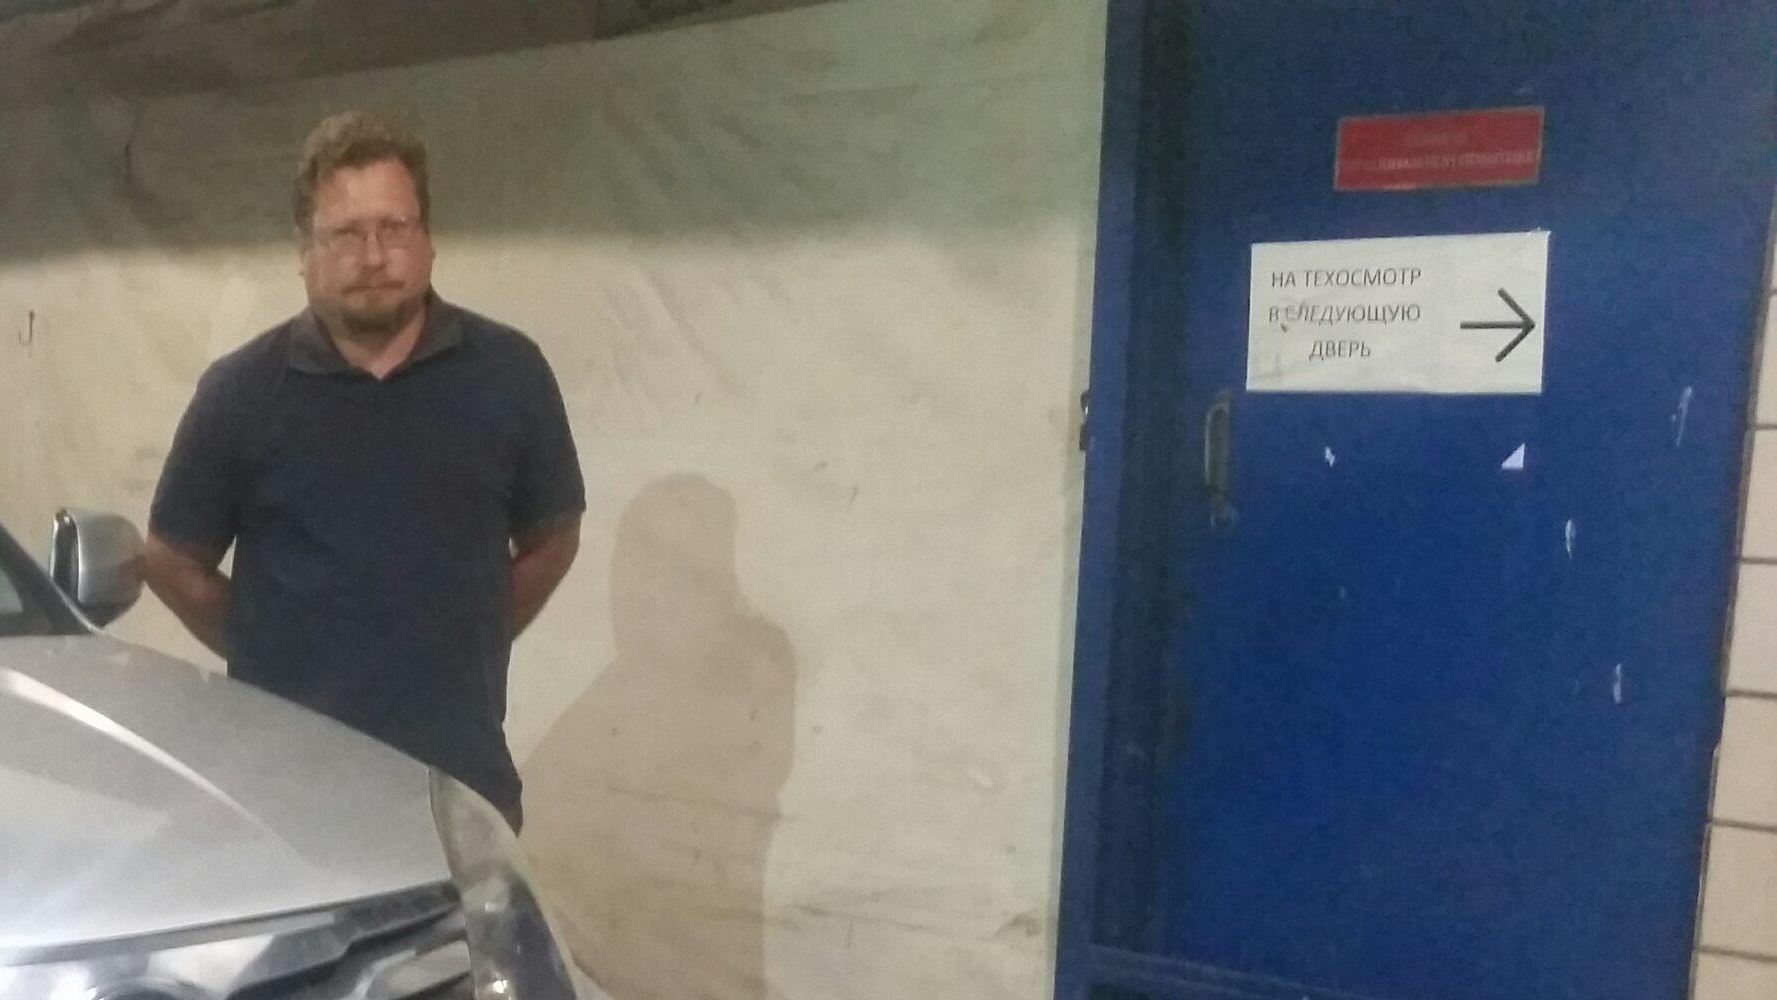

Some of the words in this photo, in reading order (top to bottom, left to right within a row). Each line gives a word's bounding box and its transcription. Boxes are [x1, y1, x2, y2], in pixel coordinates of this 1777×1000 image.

[1271, 270, 1297, 289] НА
[1305, 266, 1422, 288] ТЕХОСМОТР
[1268, 305, 1280, 323] В
[1284, 303, 1422, 326] СЛЕДУЮЩУЮ
[1308, 339, 1372, 361] ДВЕРЬ
